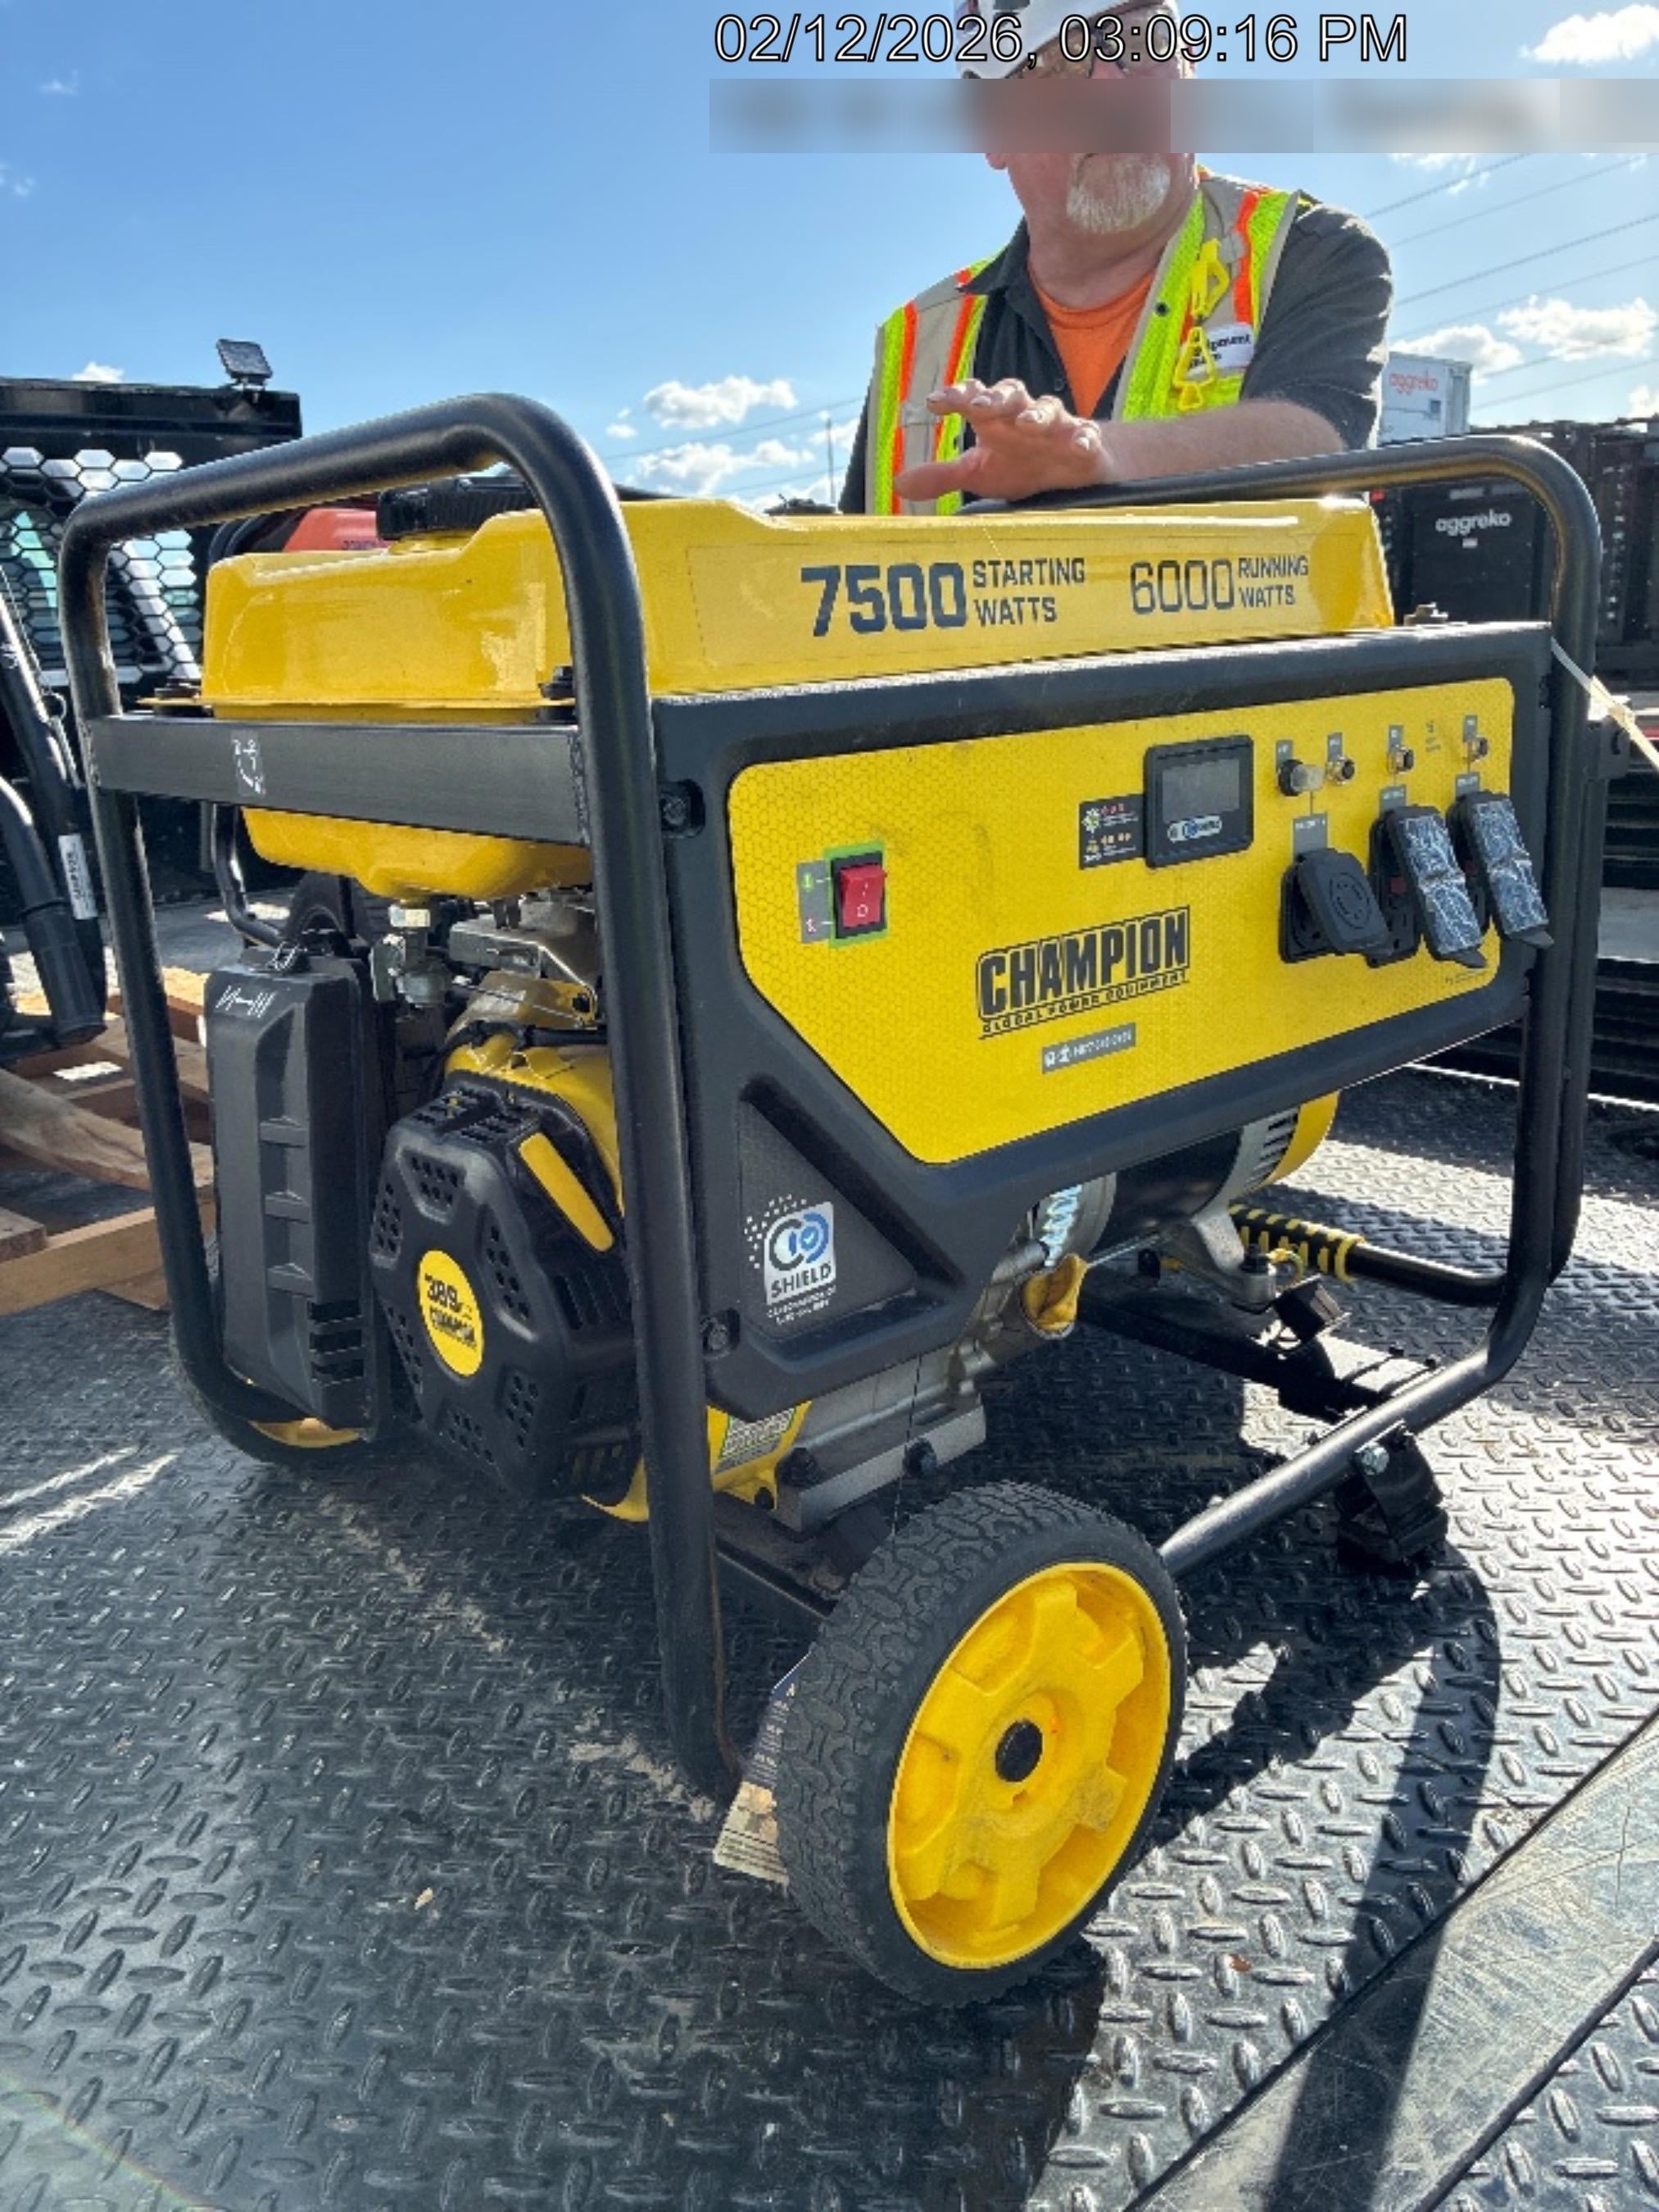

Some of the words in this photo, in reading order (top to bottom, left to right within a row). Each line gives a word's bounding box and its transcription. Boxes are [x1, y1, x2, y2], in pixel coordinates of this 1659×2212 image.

[1389, 373, 1438, 394] aggreko
[1435, 510, 1512, 537] aggreko
[800, 562, 967, 637] 7500
[972, 557, 1086, 587] STARTING
[1130, 560, 1235, 614] 6000
[1238, 555, 1309, 578] RUNNING
[1239, 584, 1296, 608] WATTS
[973, 596, 1058, 627] WATTS
[979, 909, 1187, 1018] CHAMPION
[771, 1262, 832, 1299] SHIELD
